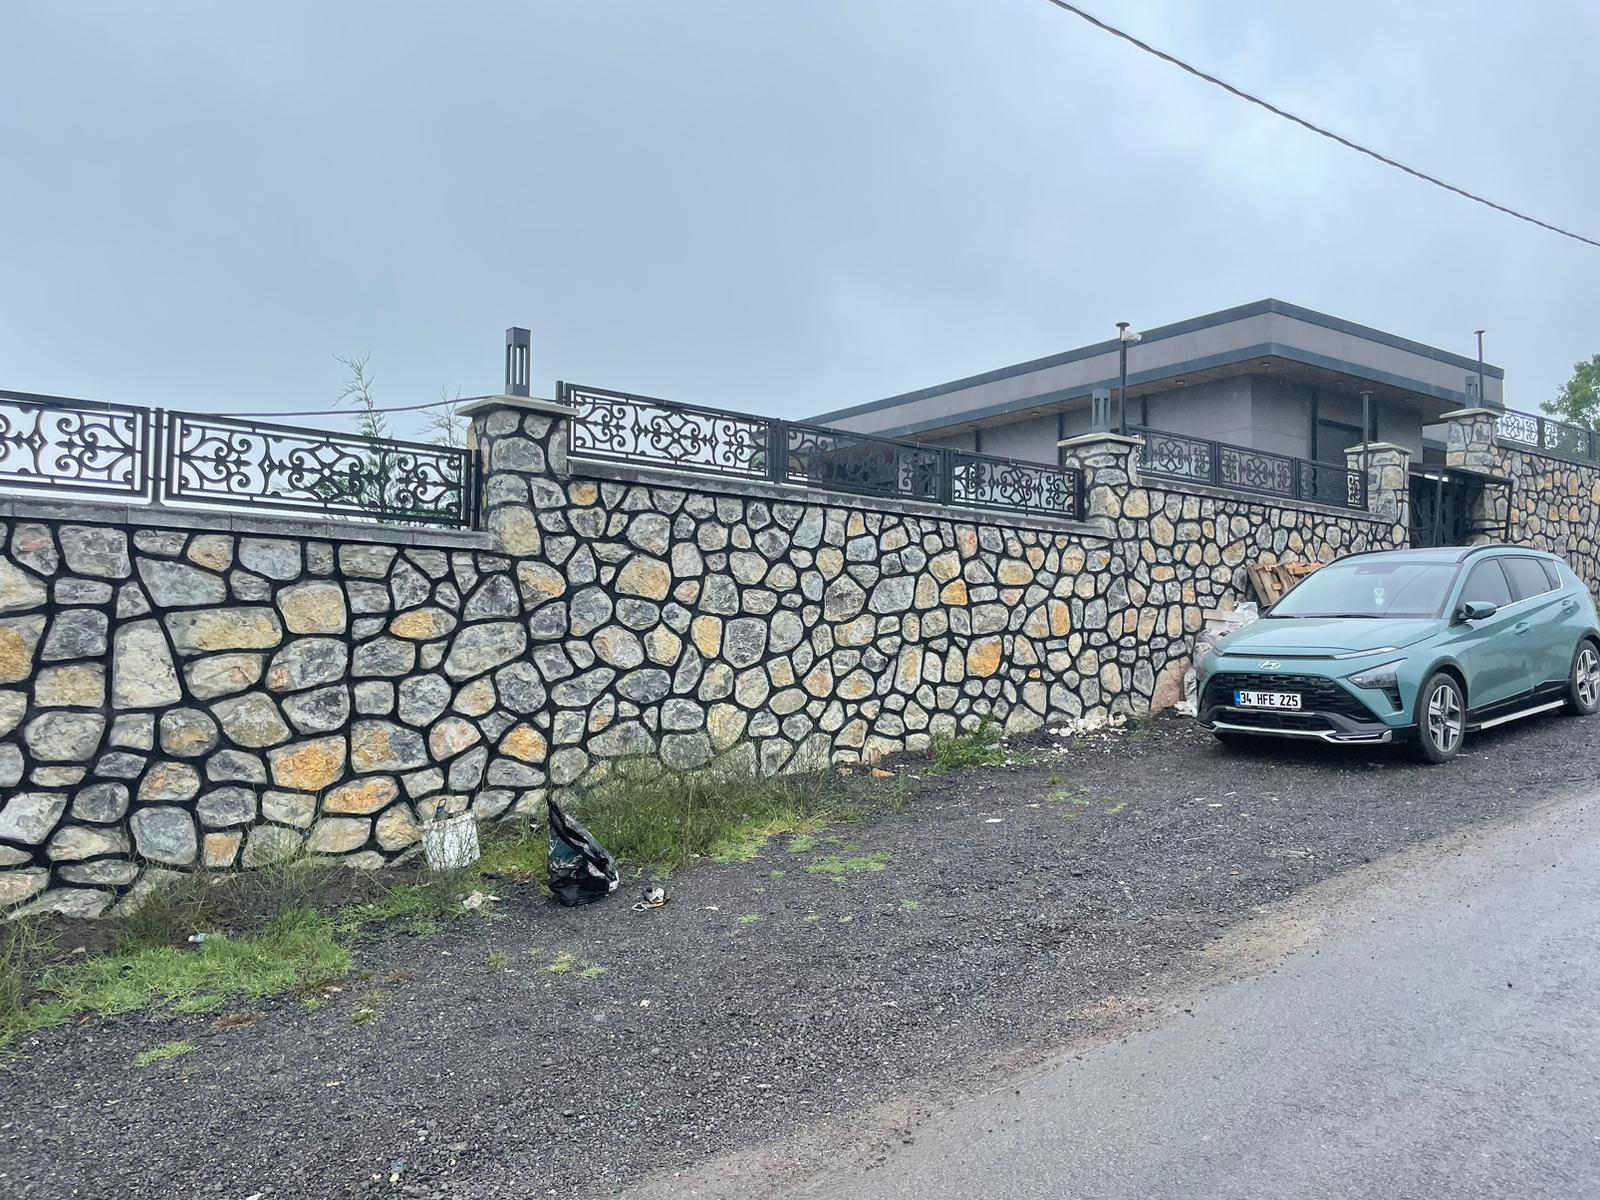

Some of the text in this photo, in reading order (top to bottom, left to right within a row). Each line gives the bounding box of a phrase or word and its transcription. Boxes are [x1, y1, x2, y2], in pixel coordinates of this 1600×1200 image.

[1241, 692, 1298, 707] 34 HFE 225
